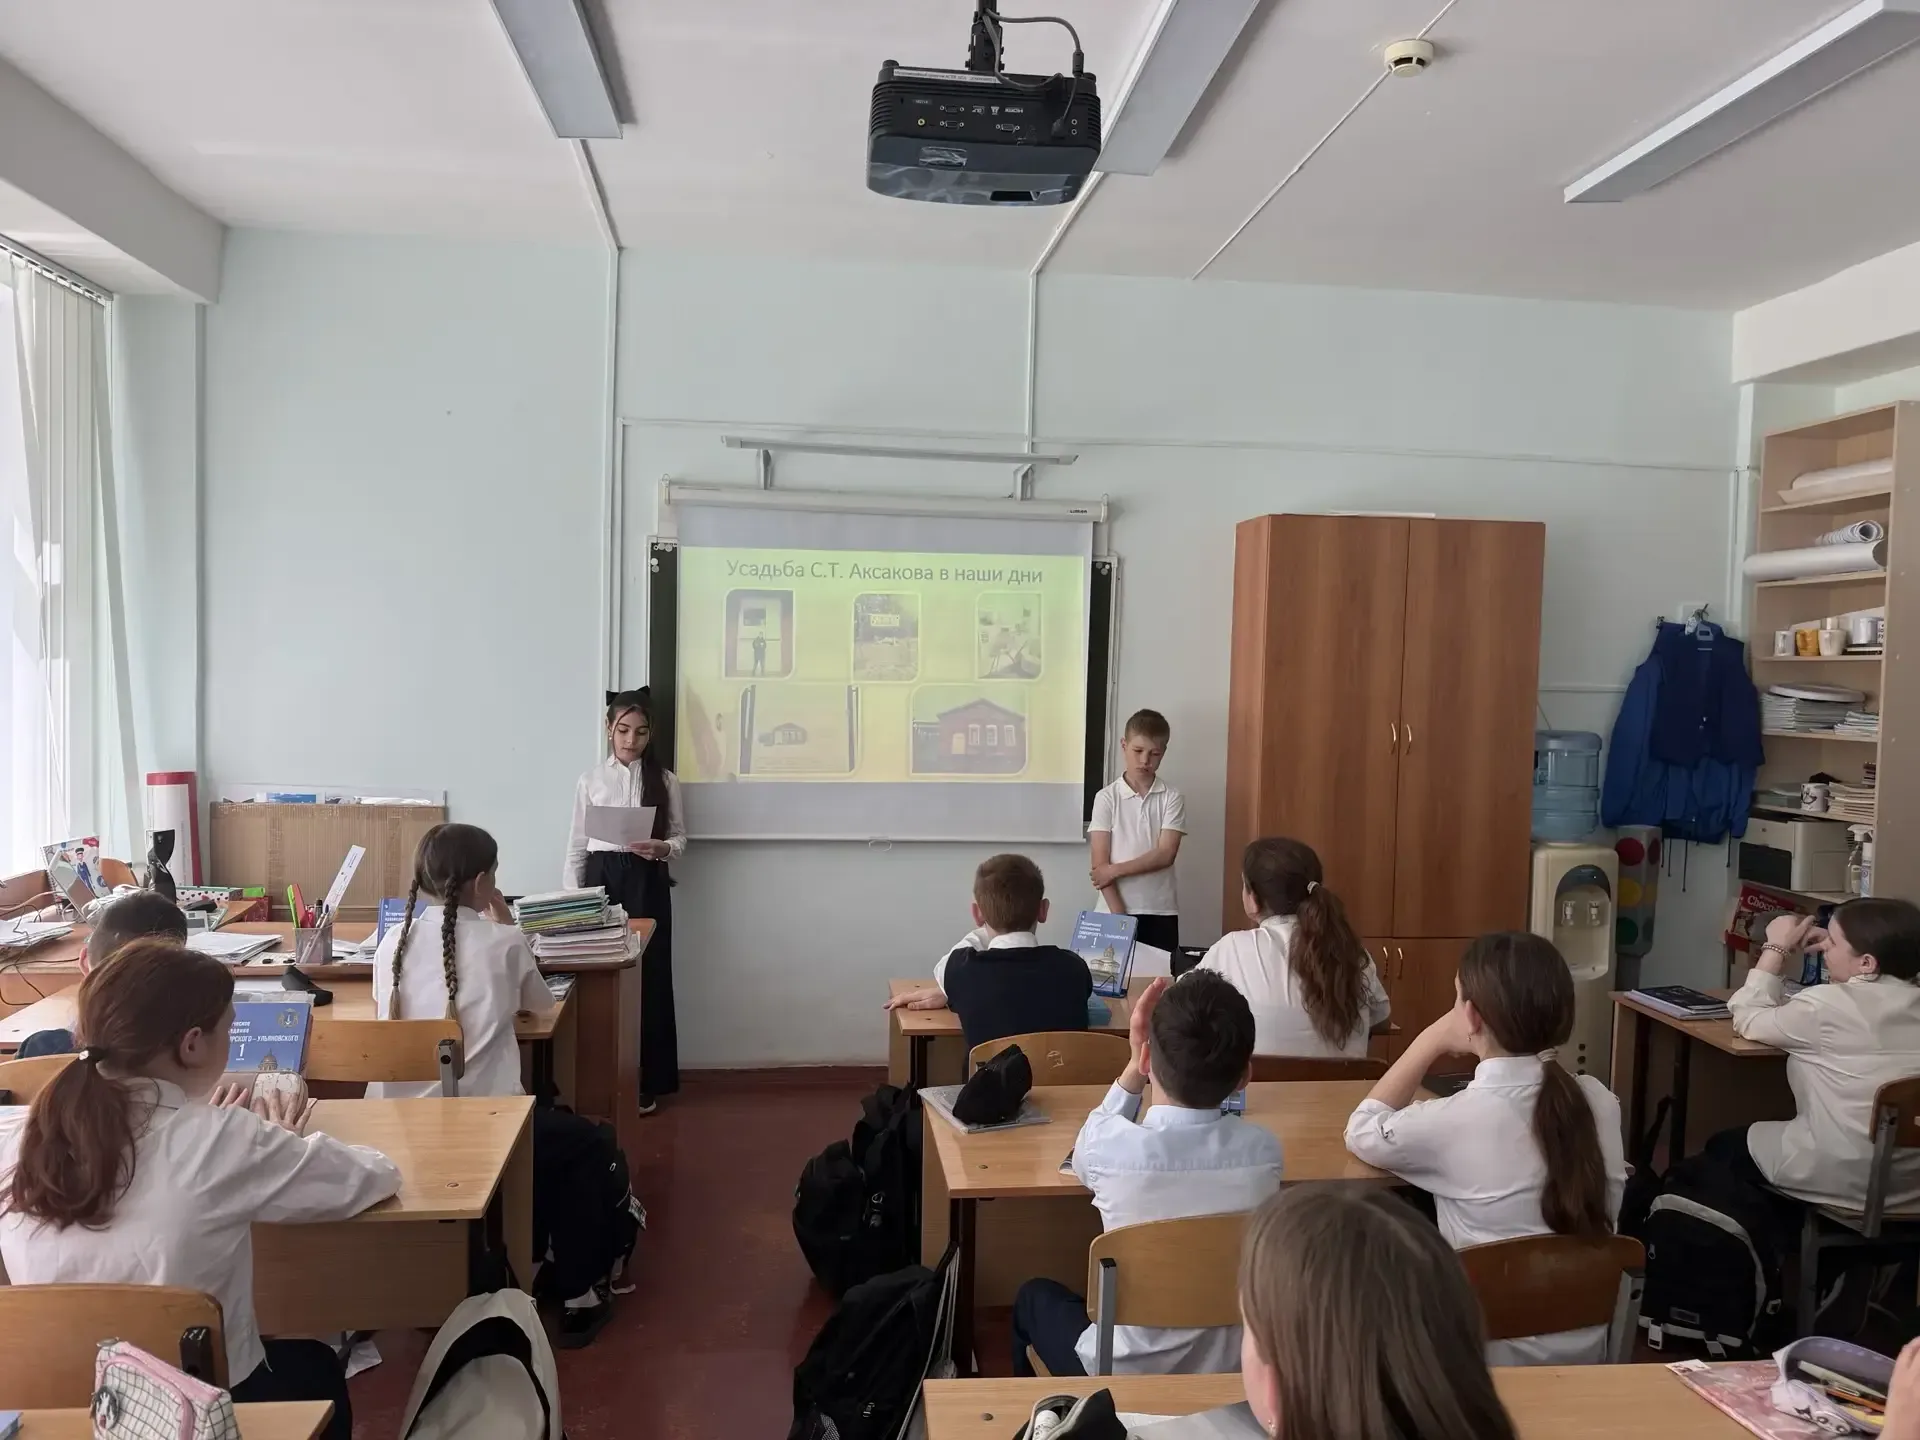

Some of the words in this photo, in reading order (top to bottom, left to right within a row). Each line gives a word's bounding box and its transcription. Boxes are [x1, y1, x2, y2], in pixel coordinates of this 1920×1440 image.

[726, 559, 805, 579] Усадьба
[810, 562, 844, 579] С.Т.
[850, 562, 934, 581] Аксакова
[940, 568, 949, 580] в
[955, 568, 1002, 582] наши
[1008, 570, 1043, 584] дни
[239, 1043, 245, 1058] 1
